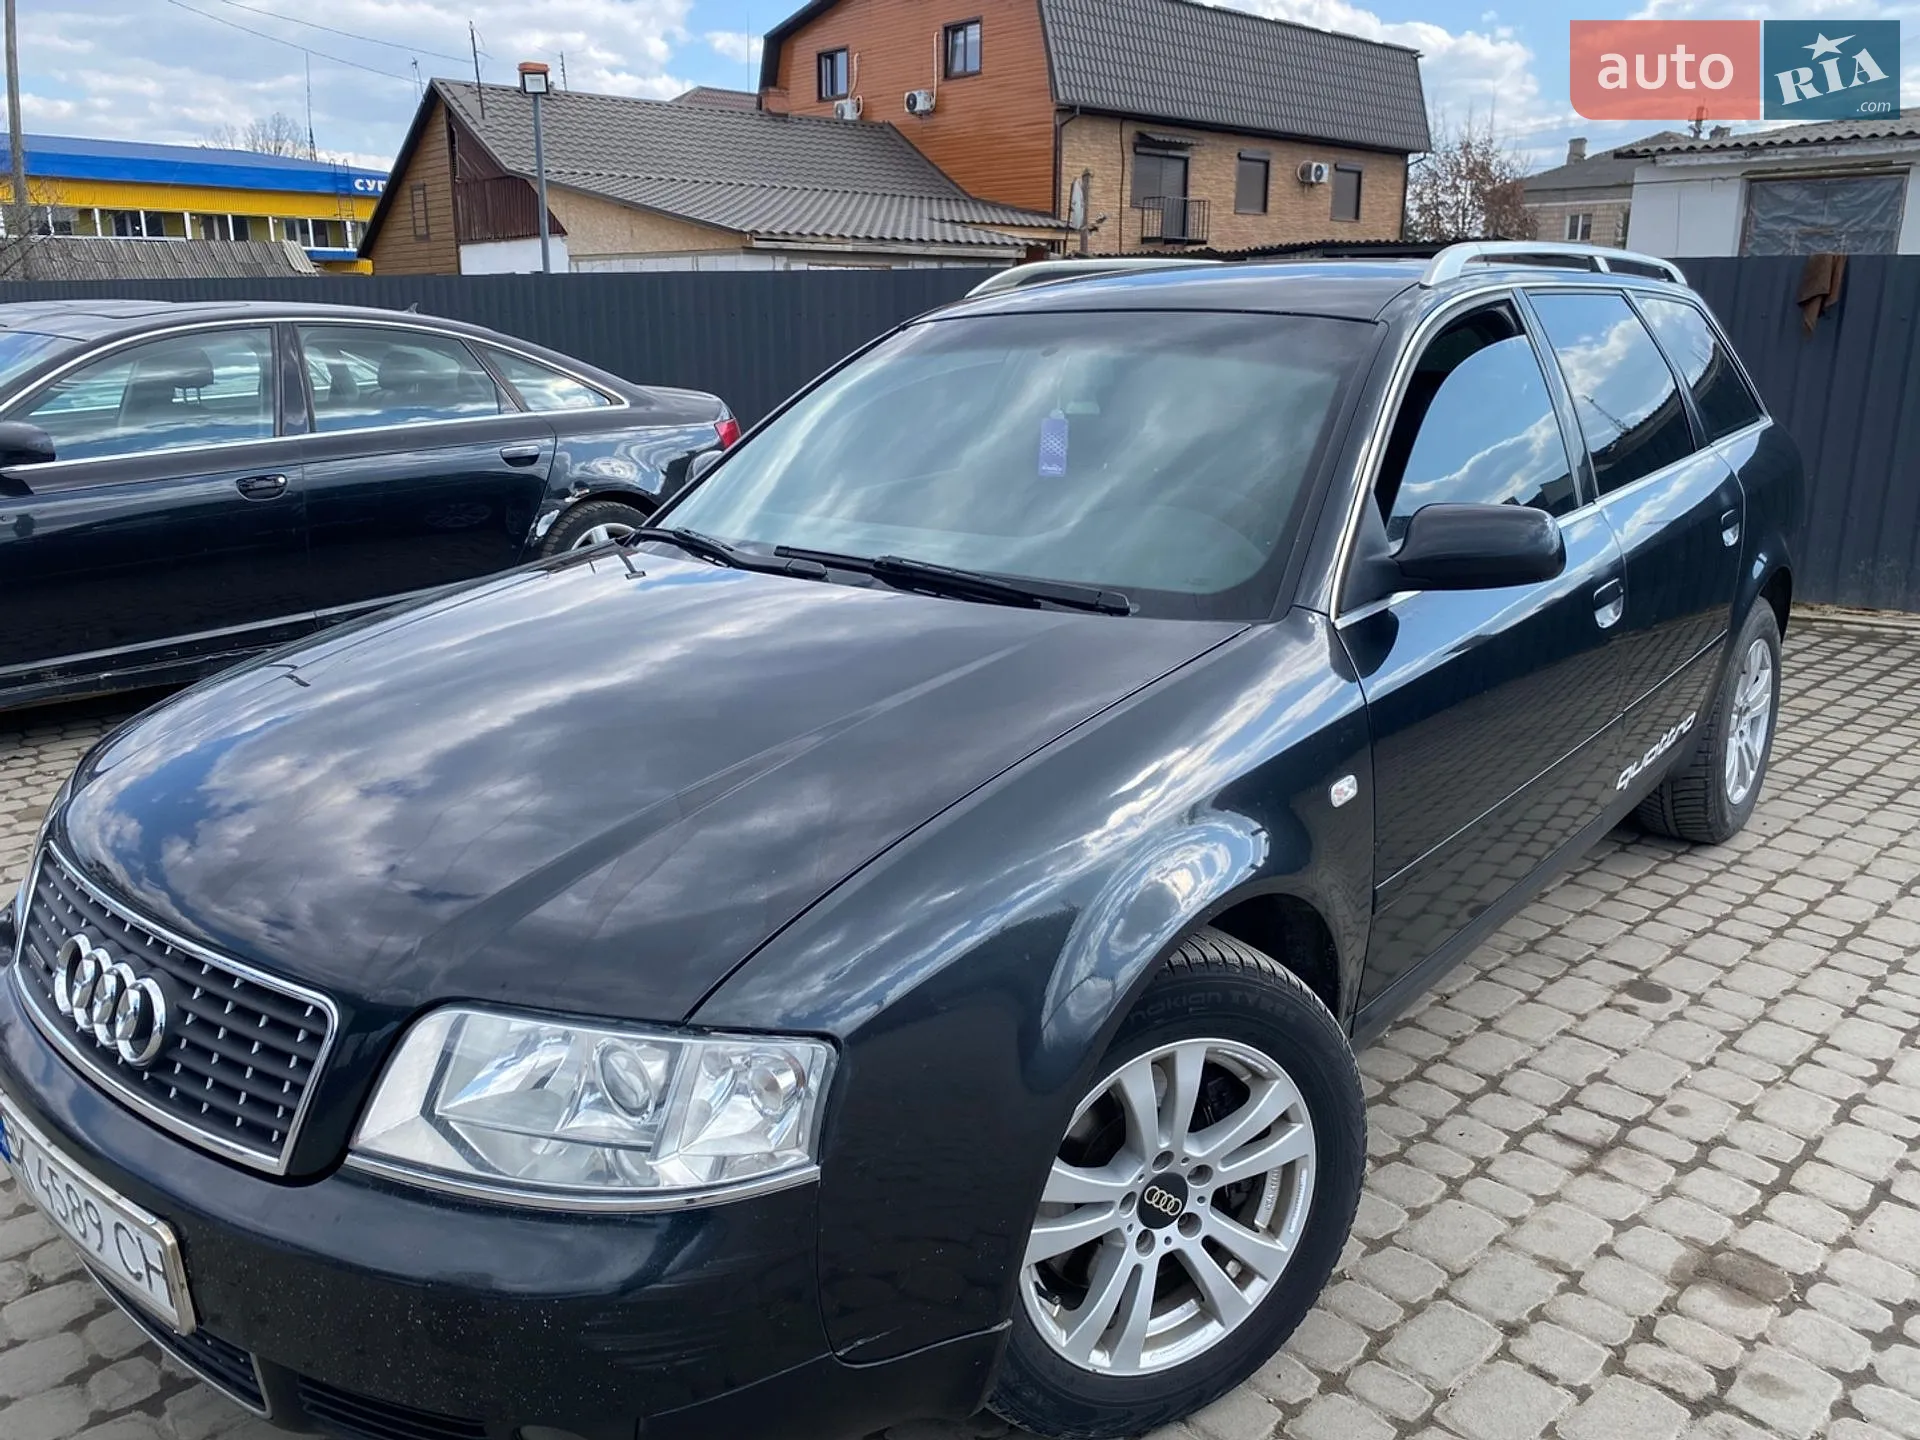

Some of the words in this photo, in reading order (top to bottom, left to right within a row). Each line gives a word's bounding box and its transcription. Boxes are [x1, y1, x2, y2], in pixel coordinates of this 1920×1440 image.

[1616, 711, 1696, 791] quattro
[37, 1156, 104, 1252] 4589
[114, 1221, 175, 1310] CH
